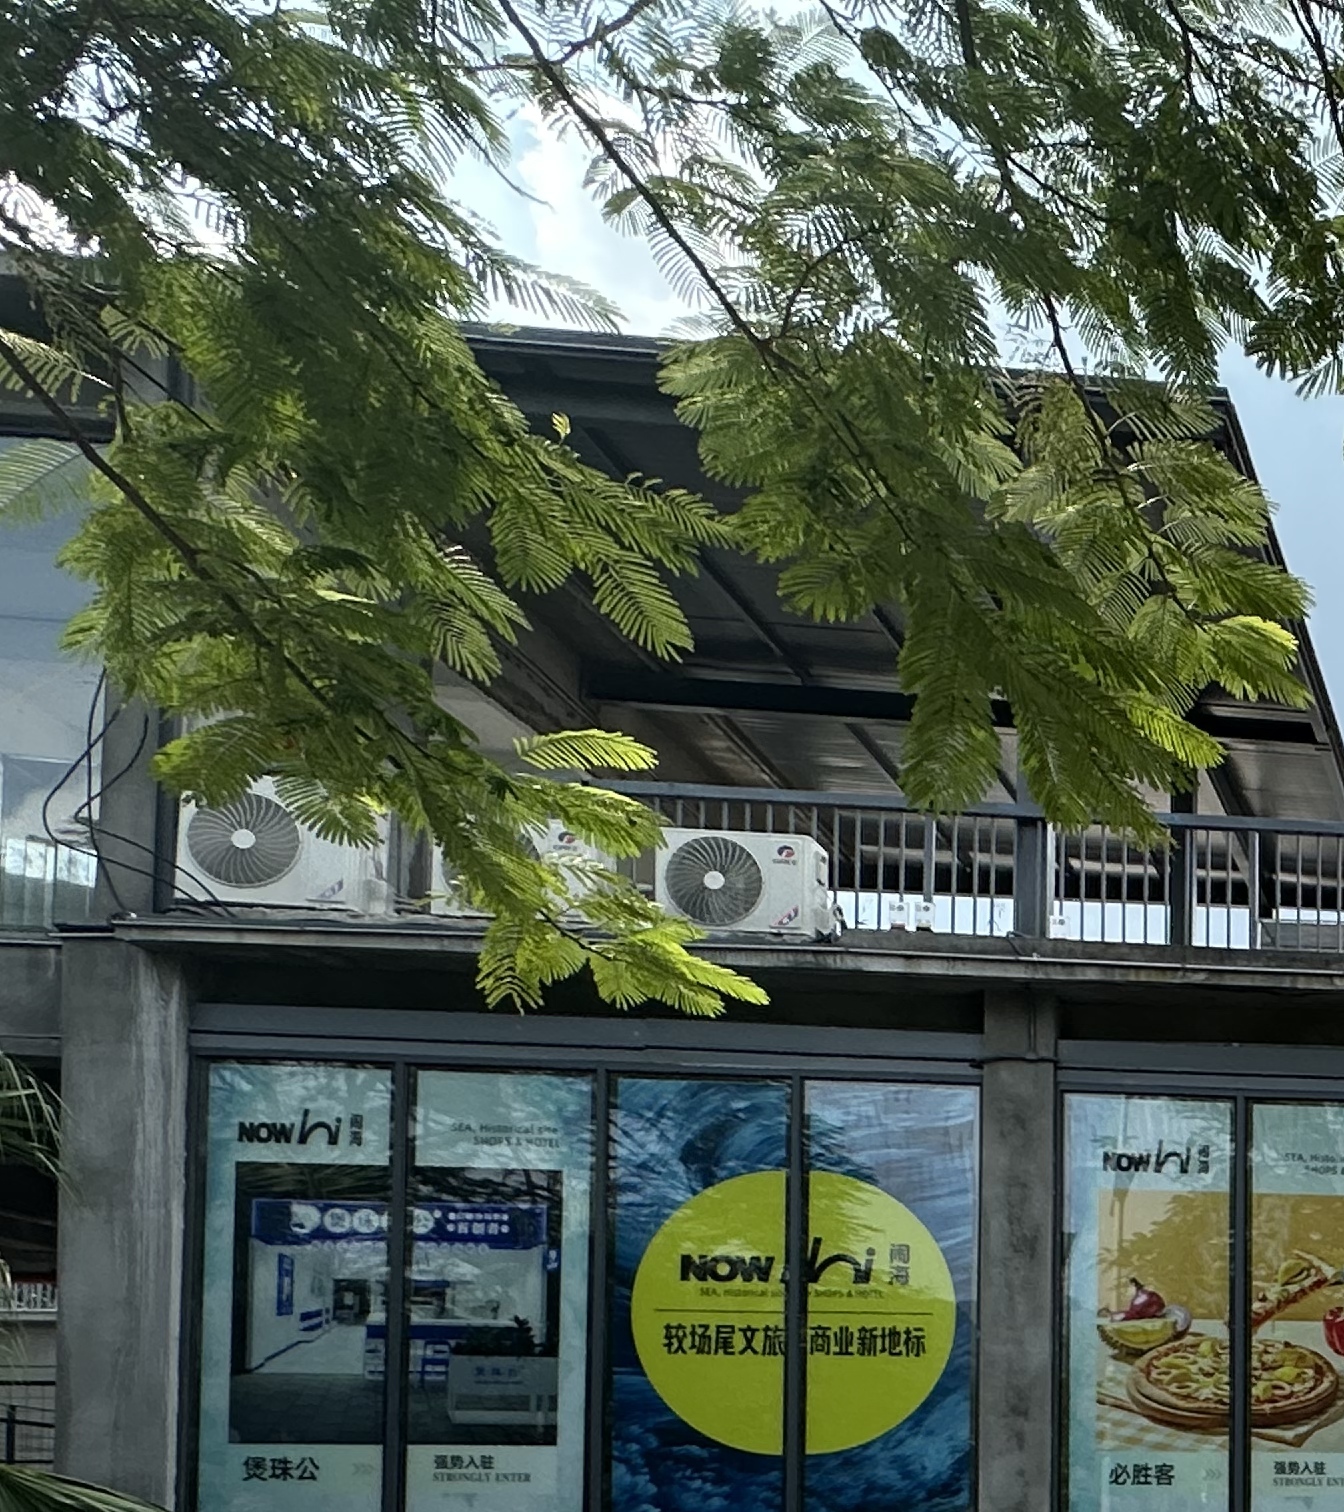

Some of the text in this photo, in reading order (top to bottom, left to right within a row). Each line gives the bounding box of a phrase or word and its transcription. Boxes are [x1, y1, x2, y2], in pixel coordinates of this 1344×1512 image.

[680, 1254, 775, 1283] NOW
[242, 1456, 319, 1481] 煲珠公
[1109, 1462, 1175, 1486] 必胜客
